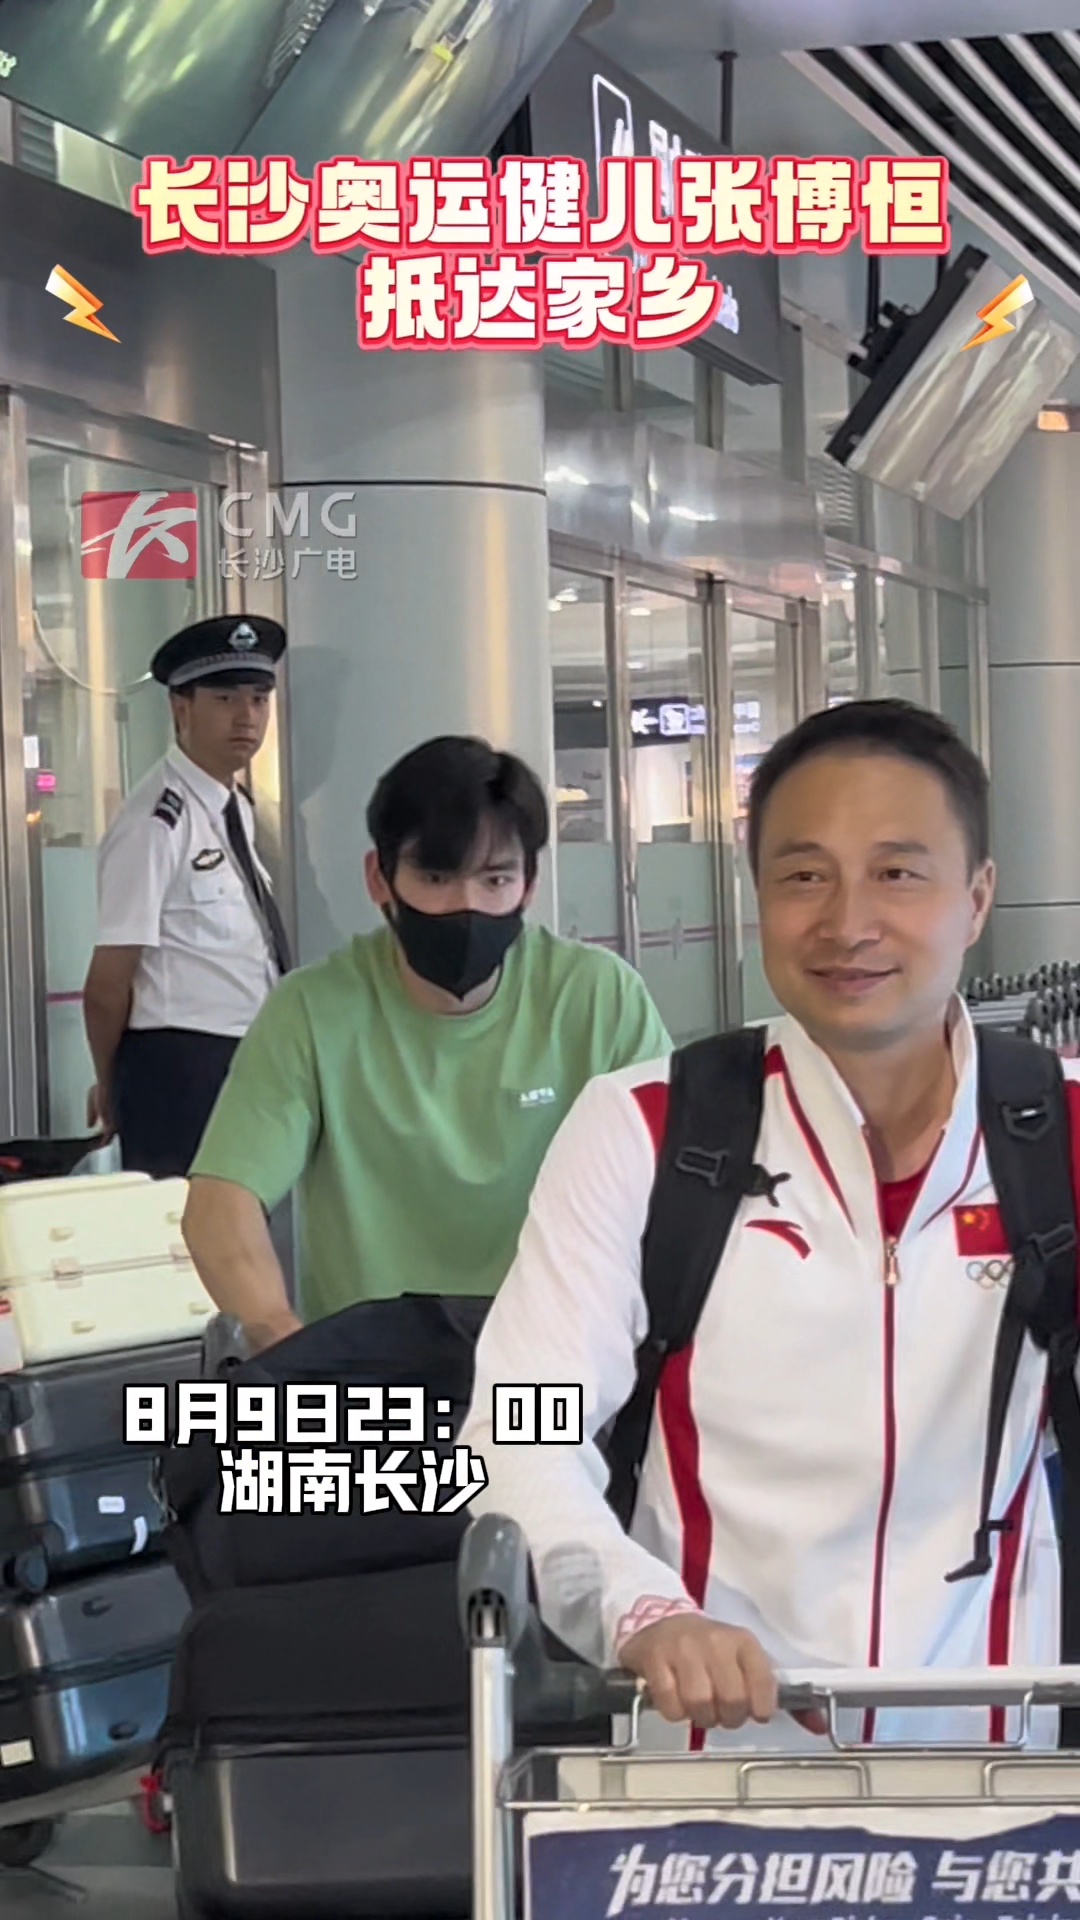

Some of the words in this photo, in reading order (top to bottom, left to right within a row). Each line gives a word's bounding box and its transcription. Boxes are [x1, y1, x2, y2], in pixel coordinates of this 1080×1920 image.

[605, 1844, 918, 1918] 为您分担风险
[931, 1849, 1080, 1905] 与您共
